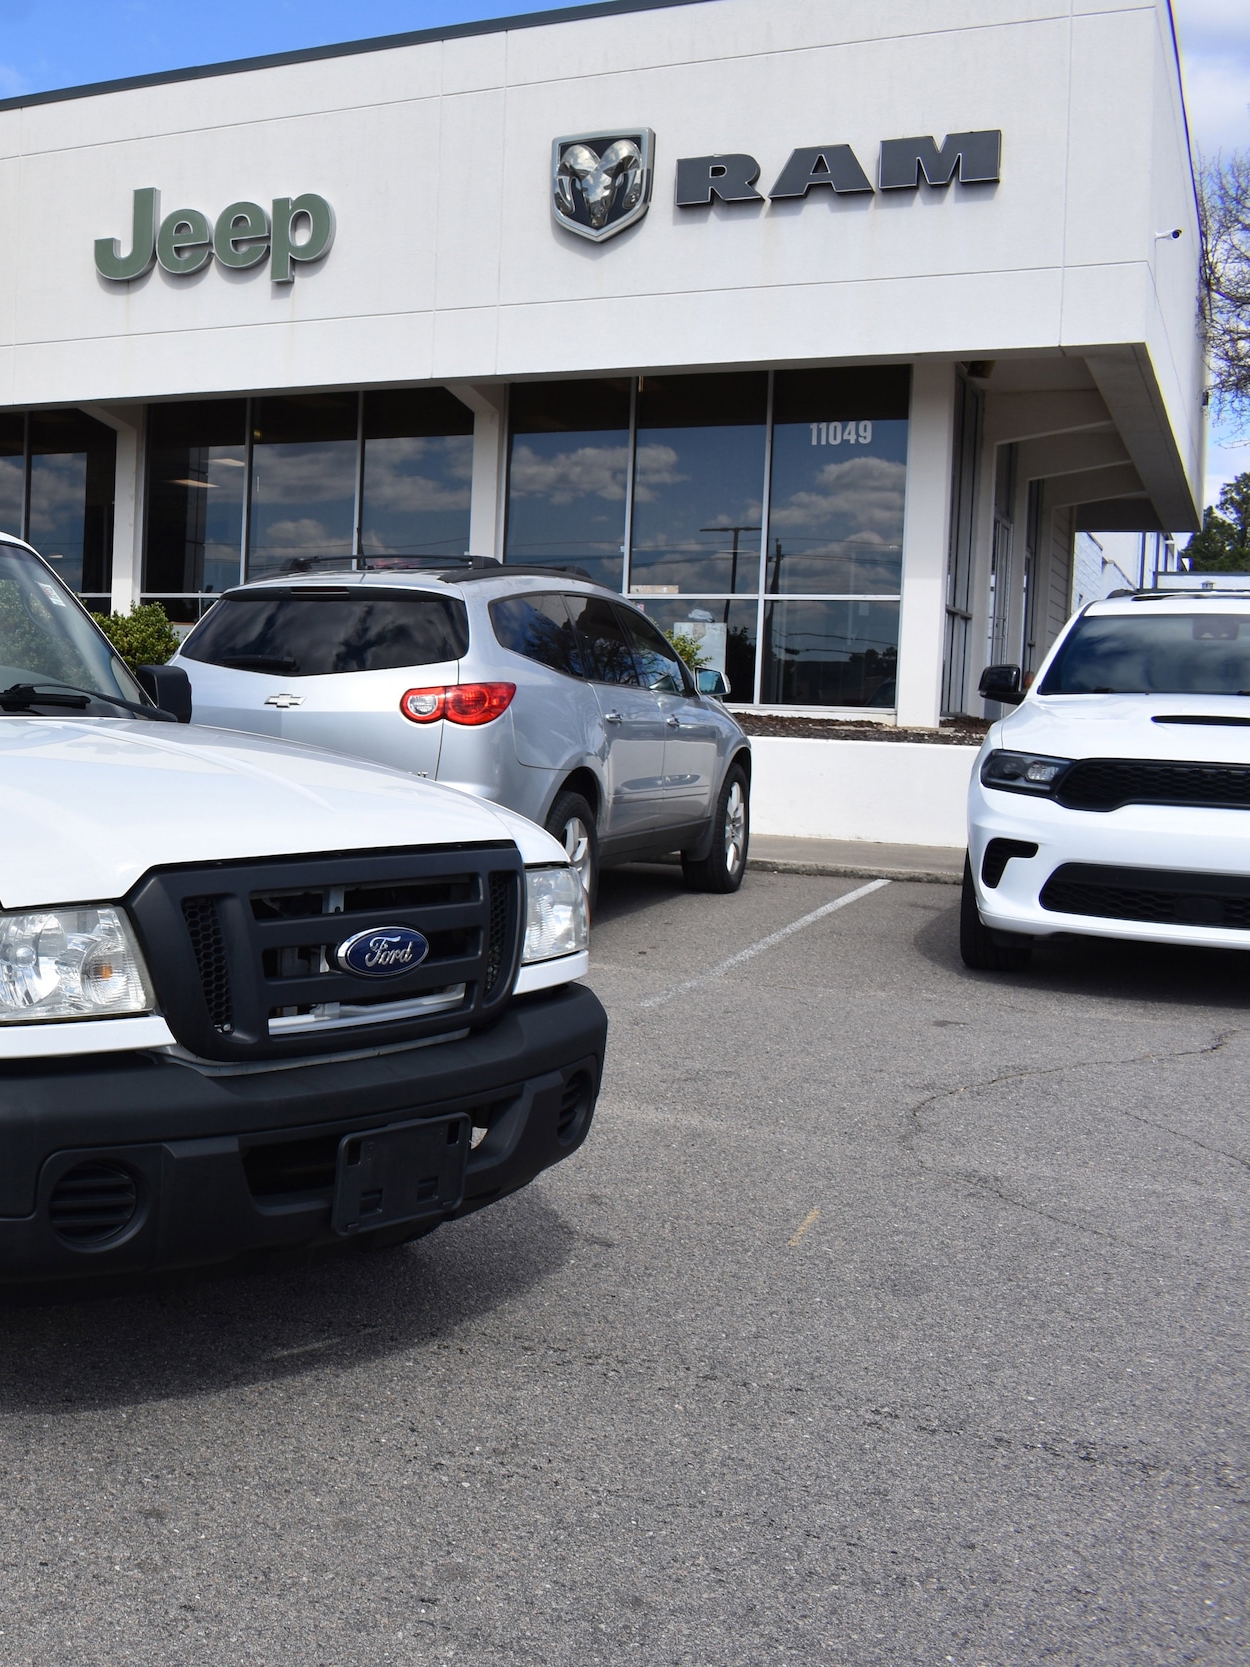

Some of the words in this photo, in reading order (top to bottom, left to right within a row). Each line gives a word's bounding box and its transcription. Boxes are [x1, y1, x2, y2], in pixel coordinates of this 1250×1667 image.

[675, 129, 1003, 207] RAM
[94, 187, 337, 284] Jeep
[810, 420, 872, 446] 11049
[365, 936, 414, 967] Ford
